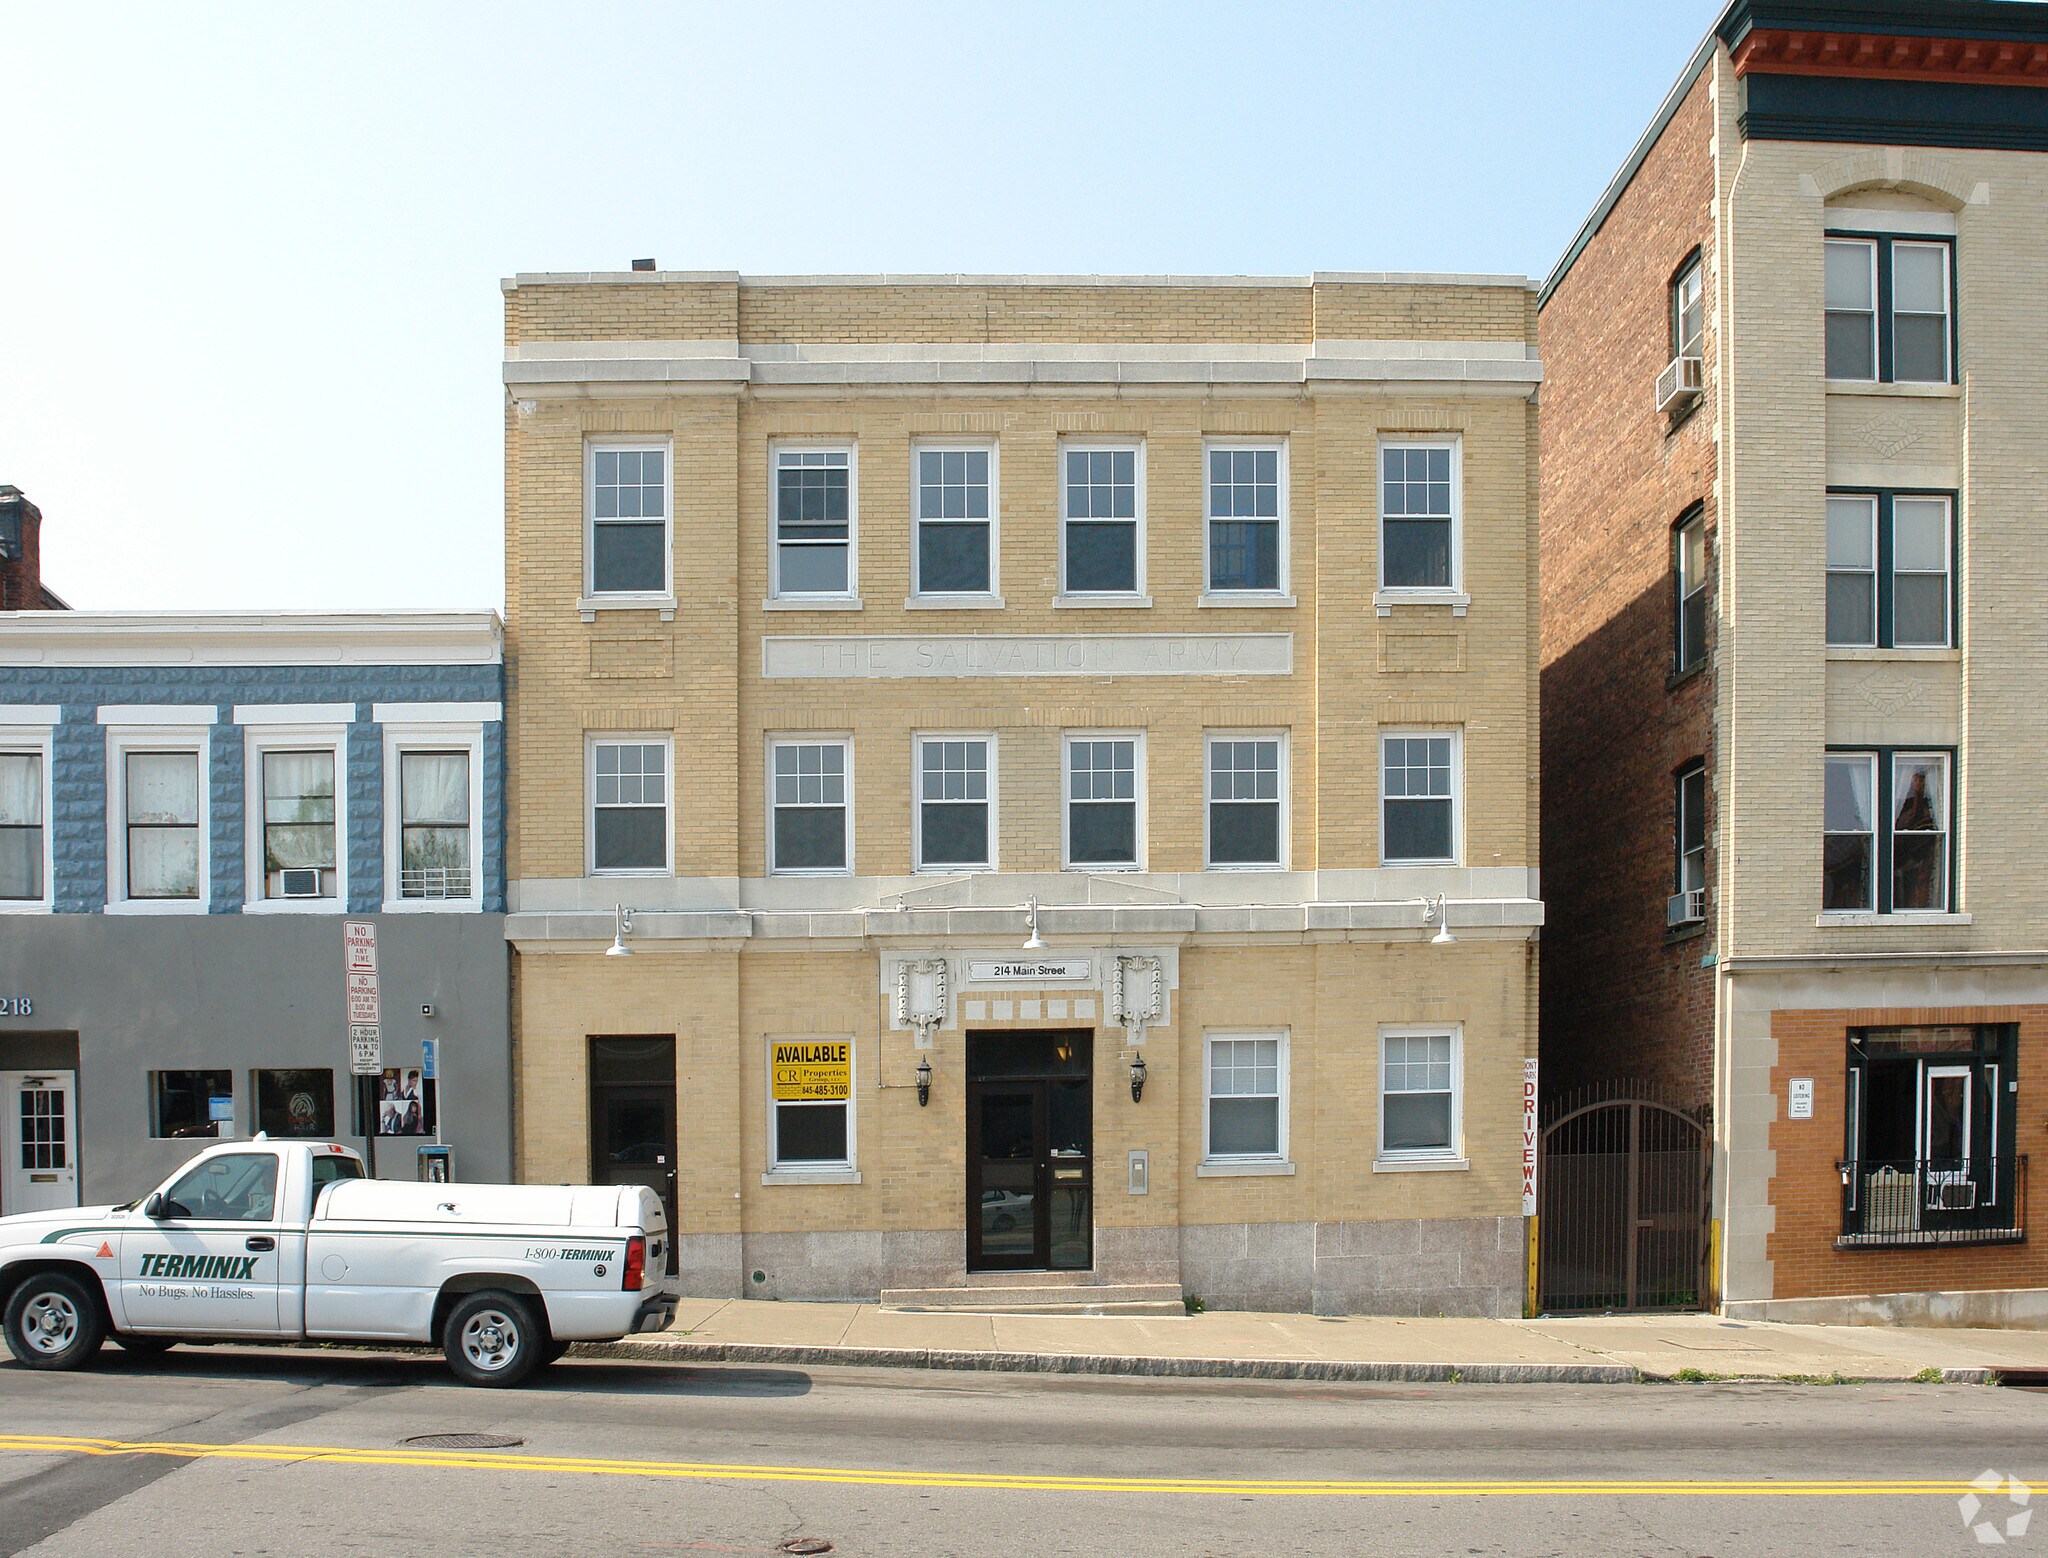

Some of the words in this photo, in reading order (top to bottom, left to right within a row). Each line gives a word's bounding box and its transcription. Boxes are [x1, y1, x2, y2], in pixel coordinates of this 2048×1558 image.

[813, 643, 888, 669] THE
[916, 642, 1115, 668] SALVATION
[1143, 641, 1245, 668] ARMY
[354, 926, 366, 937] NO
[347, 937, 375, 948] PARKING
[354, 954, 370, 963] TIME
[994, 966, 1011, 976] 214
[1013, 966, 1036, 975] Main
[1038, 965, 1066, 975] Street
[358, 977, 368, 986] NO
[350, 986, 377, 995] PARKING
[0, 998, 32, 1016] 218
[353, 1011, 377, 1019] TUESDAYS
[776, 1046, 847, 1062] AVAILABLE
[777, 1070, 798, 1082] CR
[803, 1069, 847, 1078] Properties
[802, 1085, 848, 1096] 845-485-3100
[524, 1248, 615, 1262] 1-800-TERMINIX
[139, 1254, 259, 1279] TERMINIX
[139, 1285, 156, 1296] No
[159, 1286, 189, 1300] Bugs.
[192, 1287, 208, 1298] No
[211, 1287, 256, 1300] Hassles.
